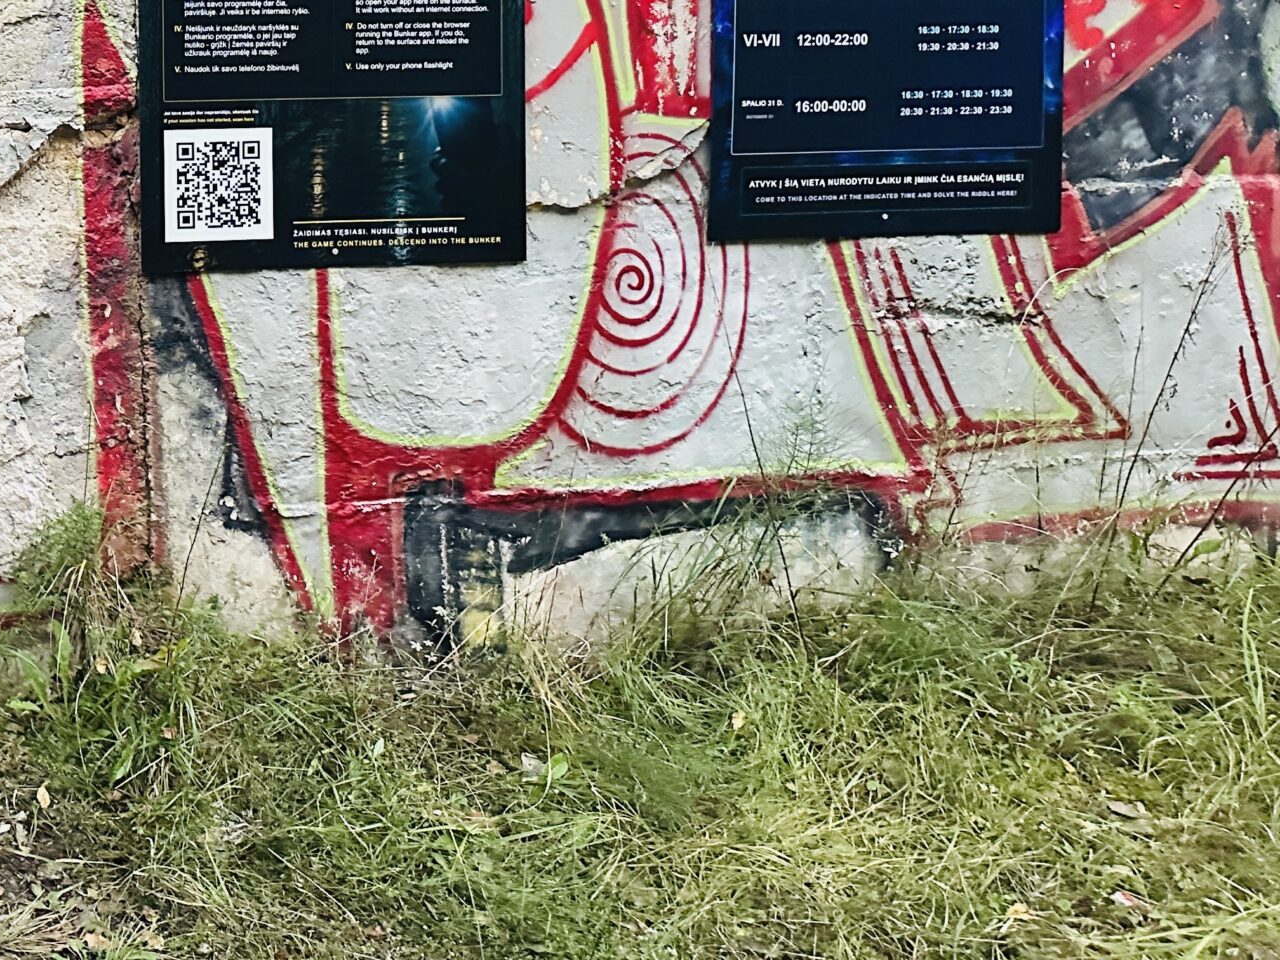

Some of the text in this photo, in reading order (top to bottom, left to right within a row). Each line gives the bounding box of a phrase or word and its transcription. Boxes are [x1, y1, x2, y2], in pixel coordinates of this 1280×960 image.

[918, 25, 1000, 35] 16:30 17:30 18:30
[743, 33, 780, 47] VI-VII
[797, 33, 868, 46] 12:00-22:00
[918, 41, 1000, 51] 19:30 20:30 21:30
[185, 65, 210, 73] Naudok
[371, 62, 384, 71] only
[386, 63, 400, 71] your
[402, 62, 423, 70] phone
[424, 61, 453, 70] flashlight
[901, 88, 1013, 99] 16:30 17:30 18:30 19:30
[795, 99, 866, 113] 16:00-00:00
[900, 105, 1013, 116] 20:30 21:30 22:30 23:30
[749, 180, 777, 188] ATVYK
[785, 178, 799, 188] ŠIĄ
[801, 178, 825, 188] VIETĄ
[828, 177, 874, 186] NURODYTU
[876, 176, 901, 185] LAIKU
[904, 176, 912, 184] IR
[915, 175, 938, 185] ĮMINK
[941, 174, 955, 183] ČIA
[957, 173, 994, 183] ESANČIĄ
[996, 173, 1024, 183] MĮSLĘ!
[293, 229, 331, 237] ŽAIDIMAS
[335, 228, 369, 237] TĘSIASI.
[422, 226, 457, 234] BUNKERĮ
[312, 240, 333, 248] GAME
[337, 239, 385, 247] CONTINUES.
[388, 237, 426, 246] DESCEND
[469, 236, 501, 244] BUNKER
